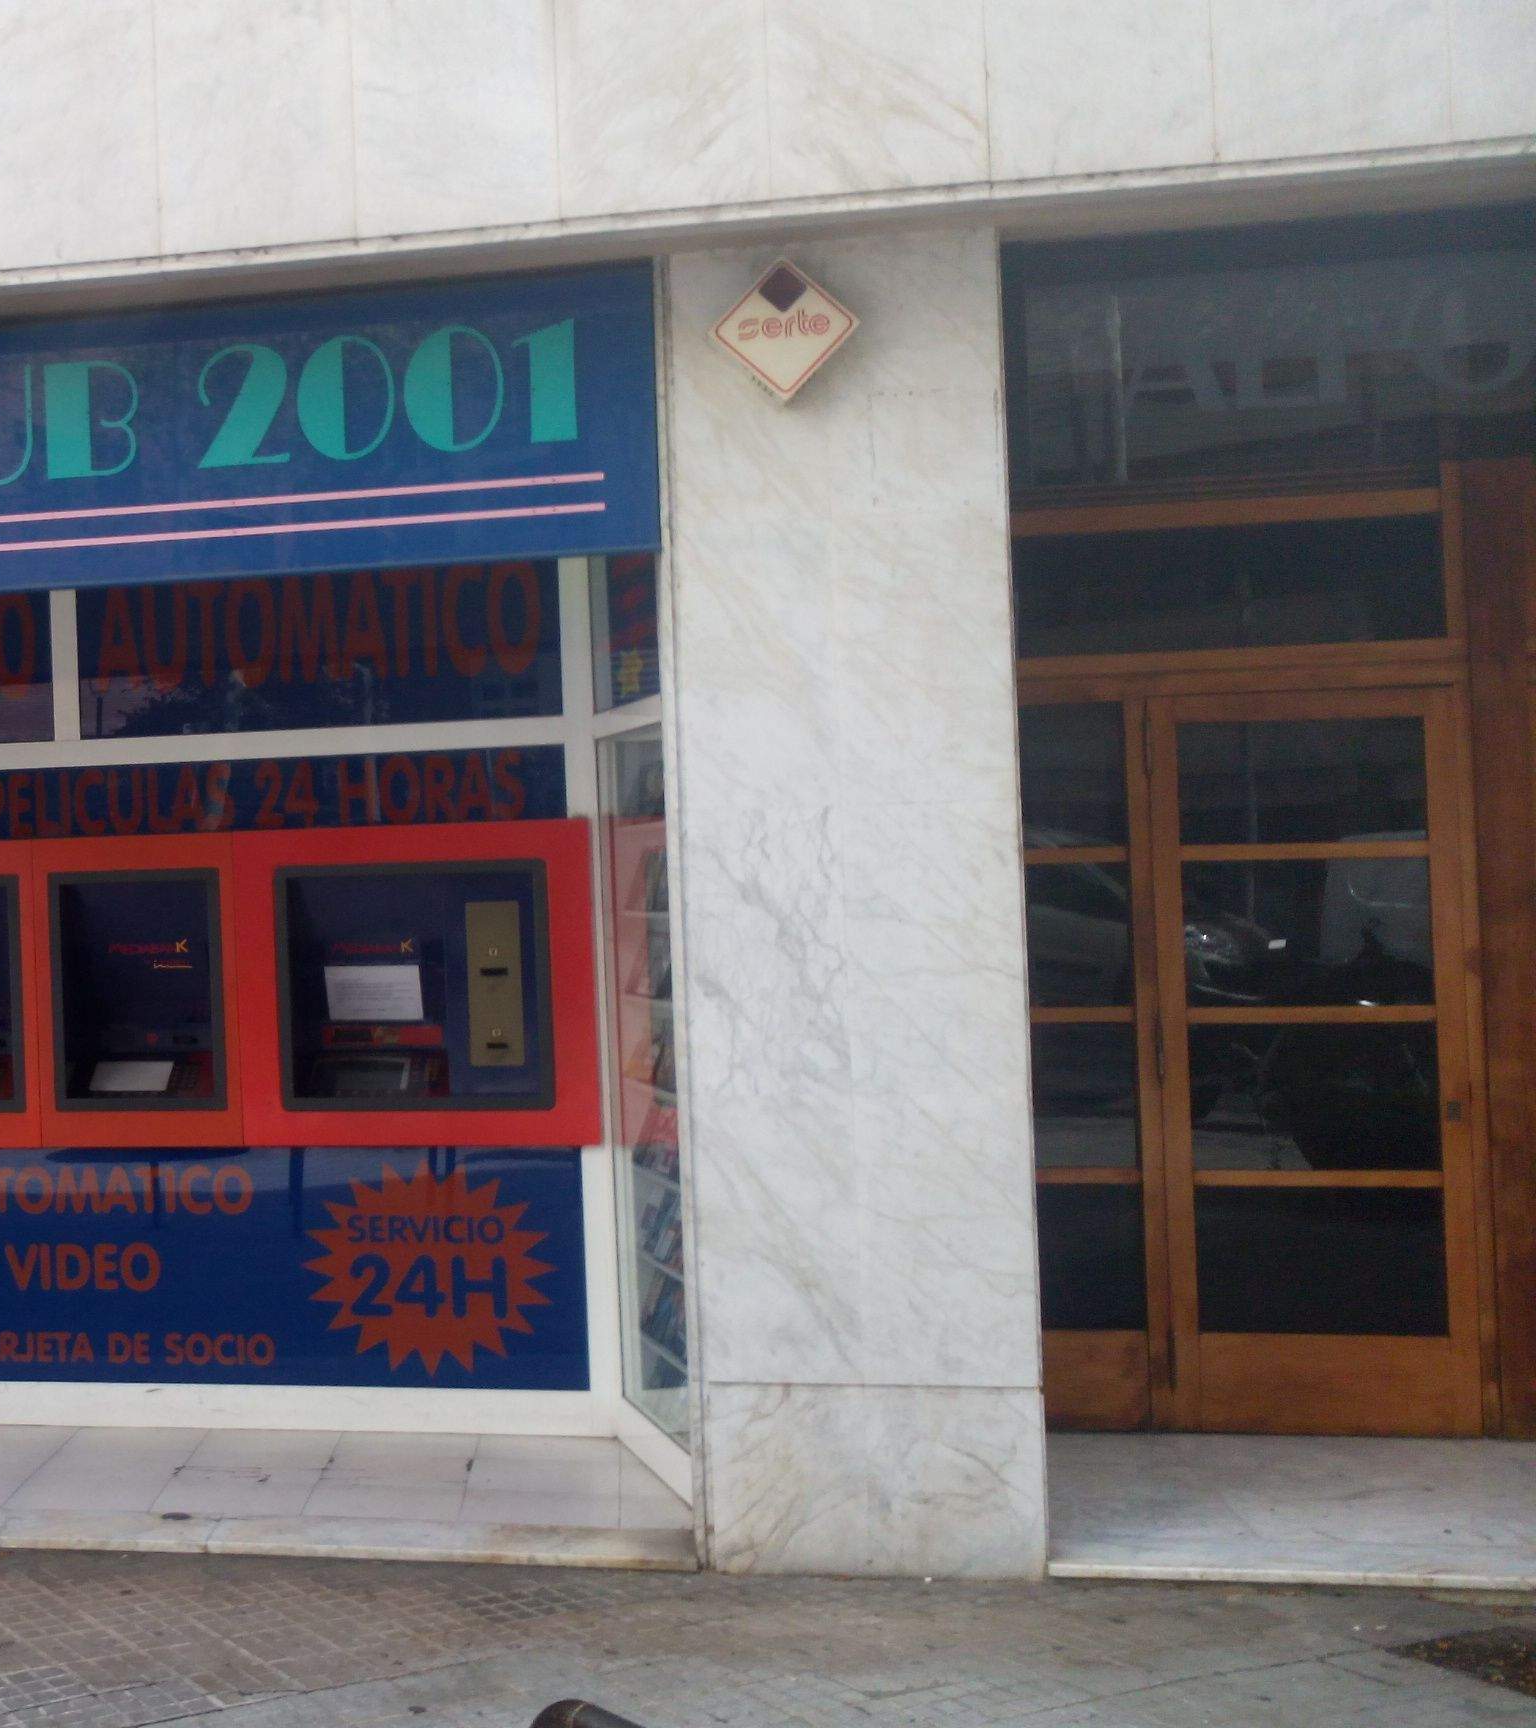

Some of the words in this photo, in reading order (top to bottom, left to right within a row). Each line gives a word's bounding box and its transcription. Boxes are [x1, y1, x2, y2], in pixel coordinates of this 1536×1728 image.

[198, 318, 578, 469] 2001
[98, 561, 542, 695] AUTOMATICO
[256, 758, 320, 830] 24
[338, 749, 527, 825] HORAS
[347, 1214, 506, 1245] SERVICIO
[4, 1241, 161, 1292] VIDEO
[350, 1254, 509, 1320] 24H
[109, 1332, 151, 1365] DE
[165, 1332, 275, 1367] SOCIO
